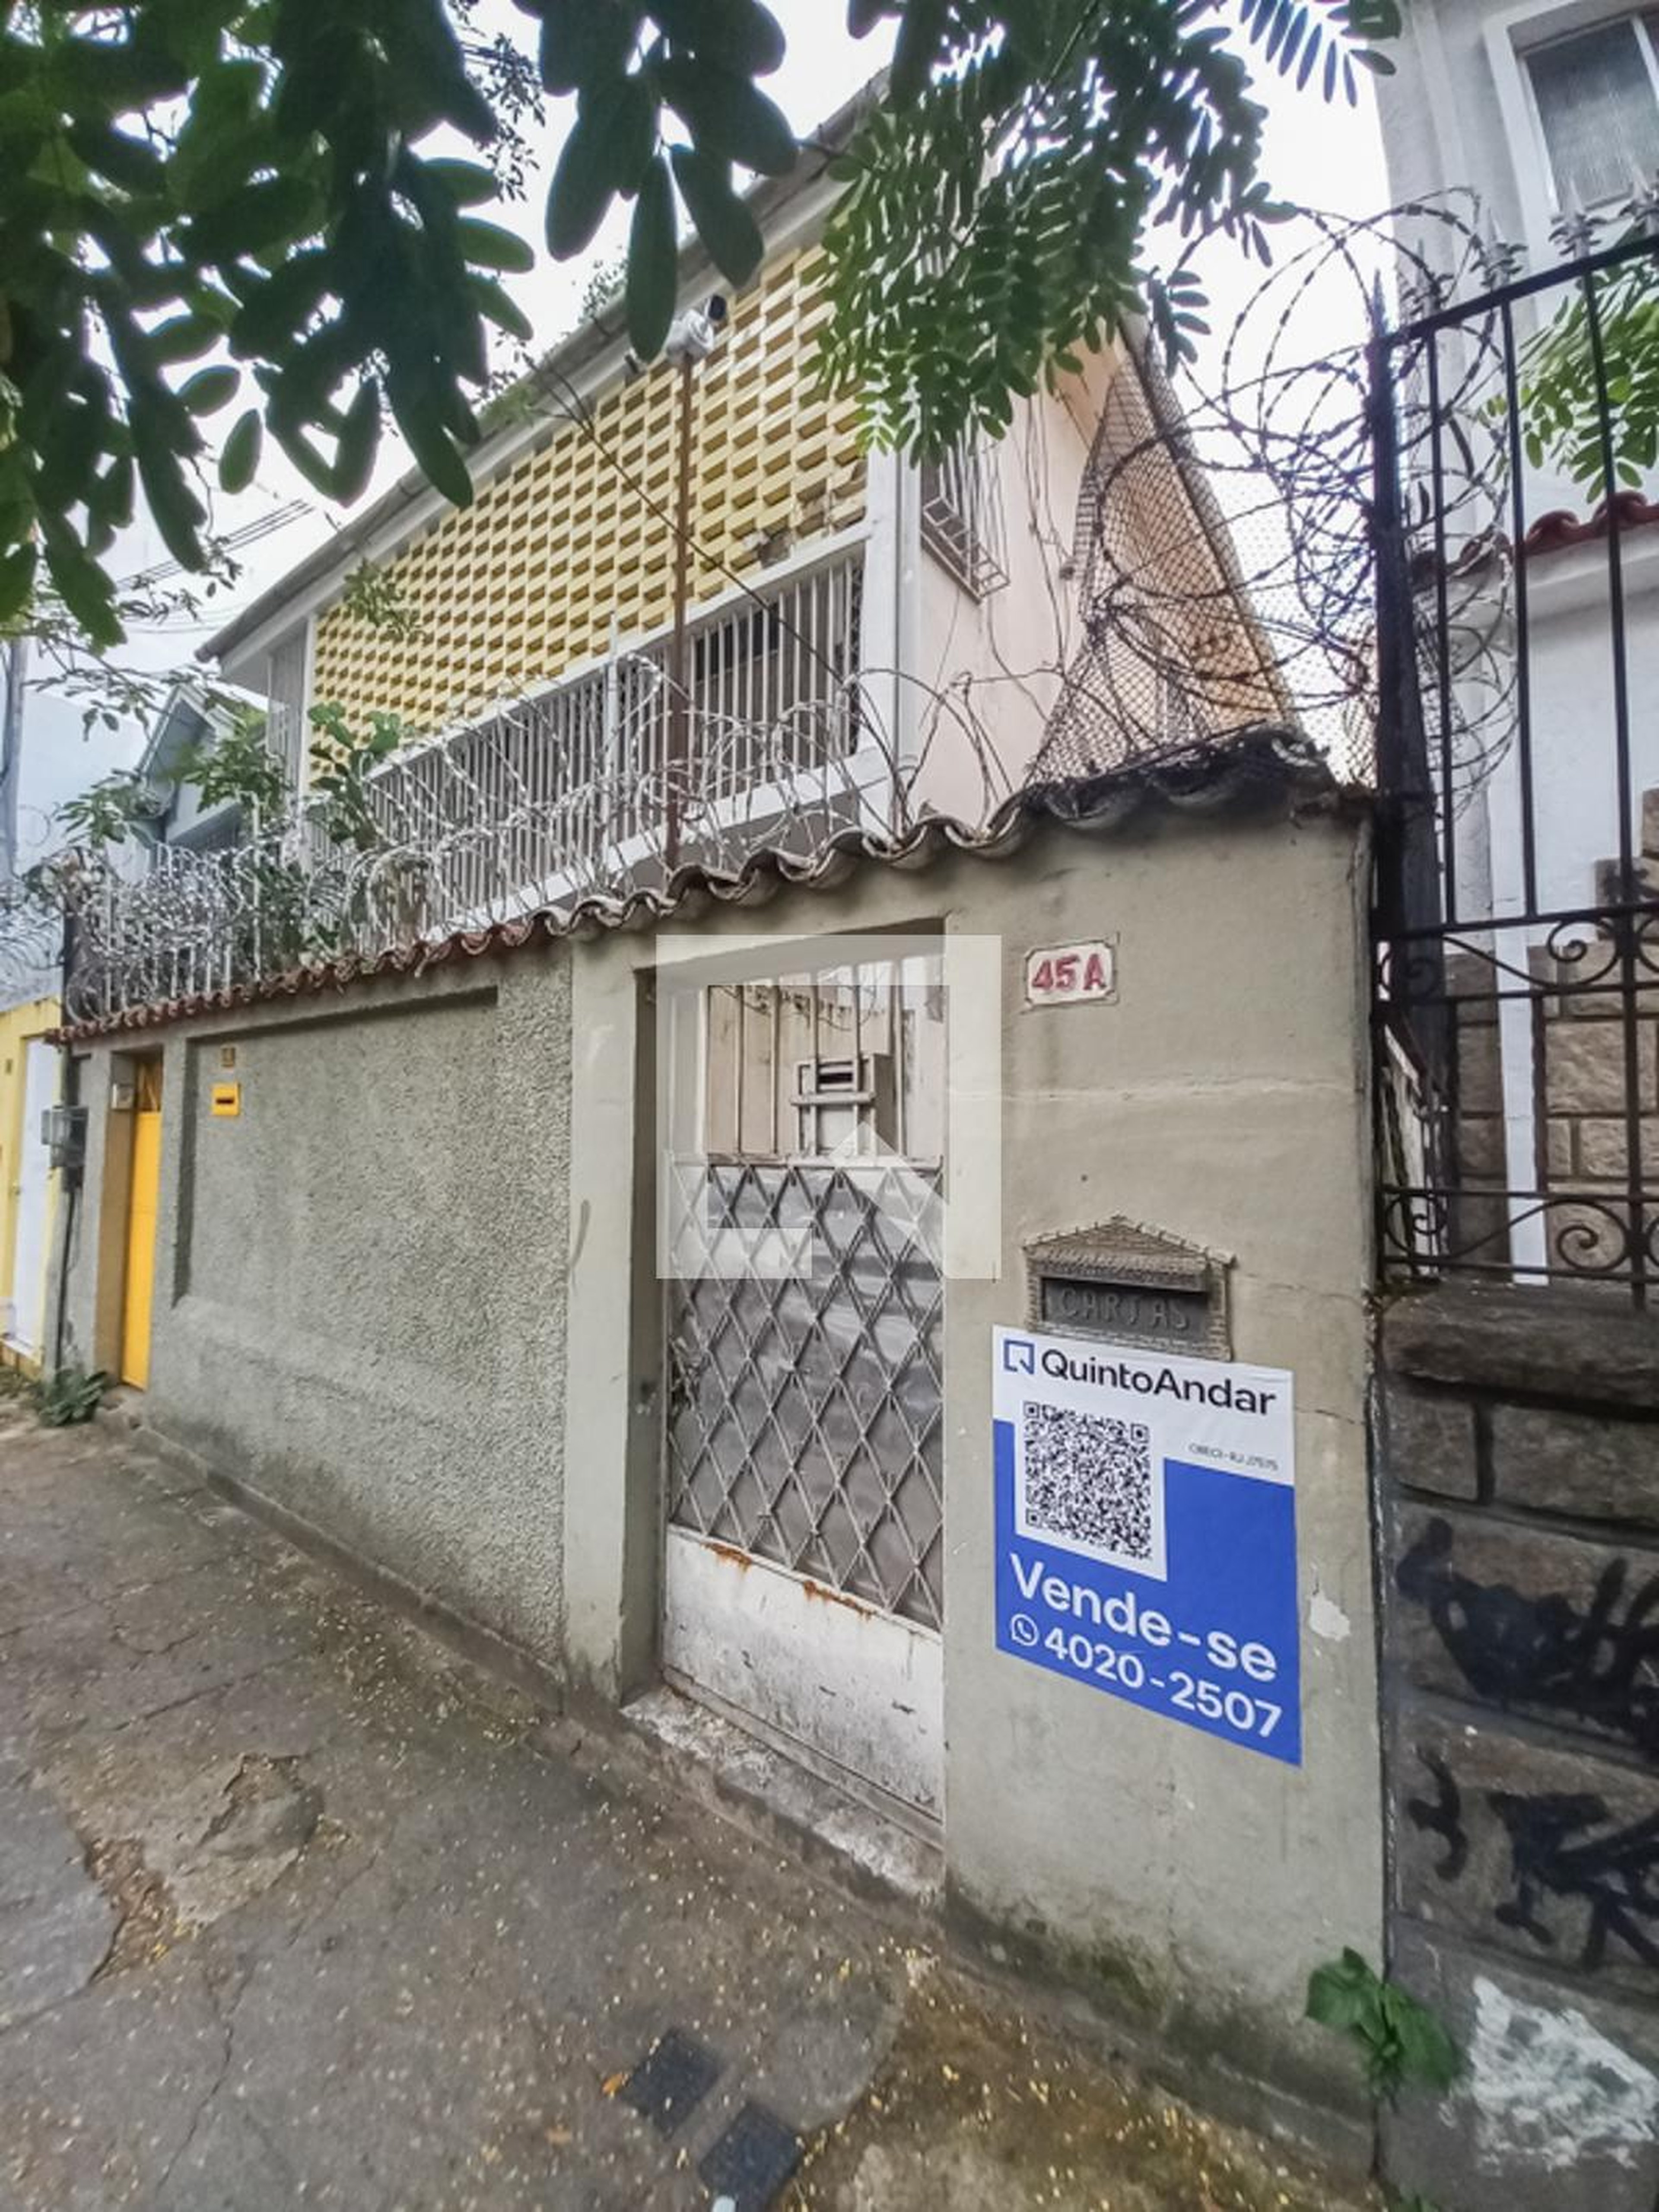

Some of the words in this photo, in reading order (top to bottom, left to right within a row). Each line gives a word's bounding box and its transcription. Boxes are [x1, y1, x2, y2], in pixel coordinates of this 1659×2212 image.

[1060, 1286, 1190, 1330] CARTAS
[1041, 1349, 1276, 1415] QuintoAndar
[1010, 1553, 1277, 1681] Vende-se
[1044, 1626, 1282, 1738] 4020-2507
